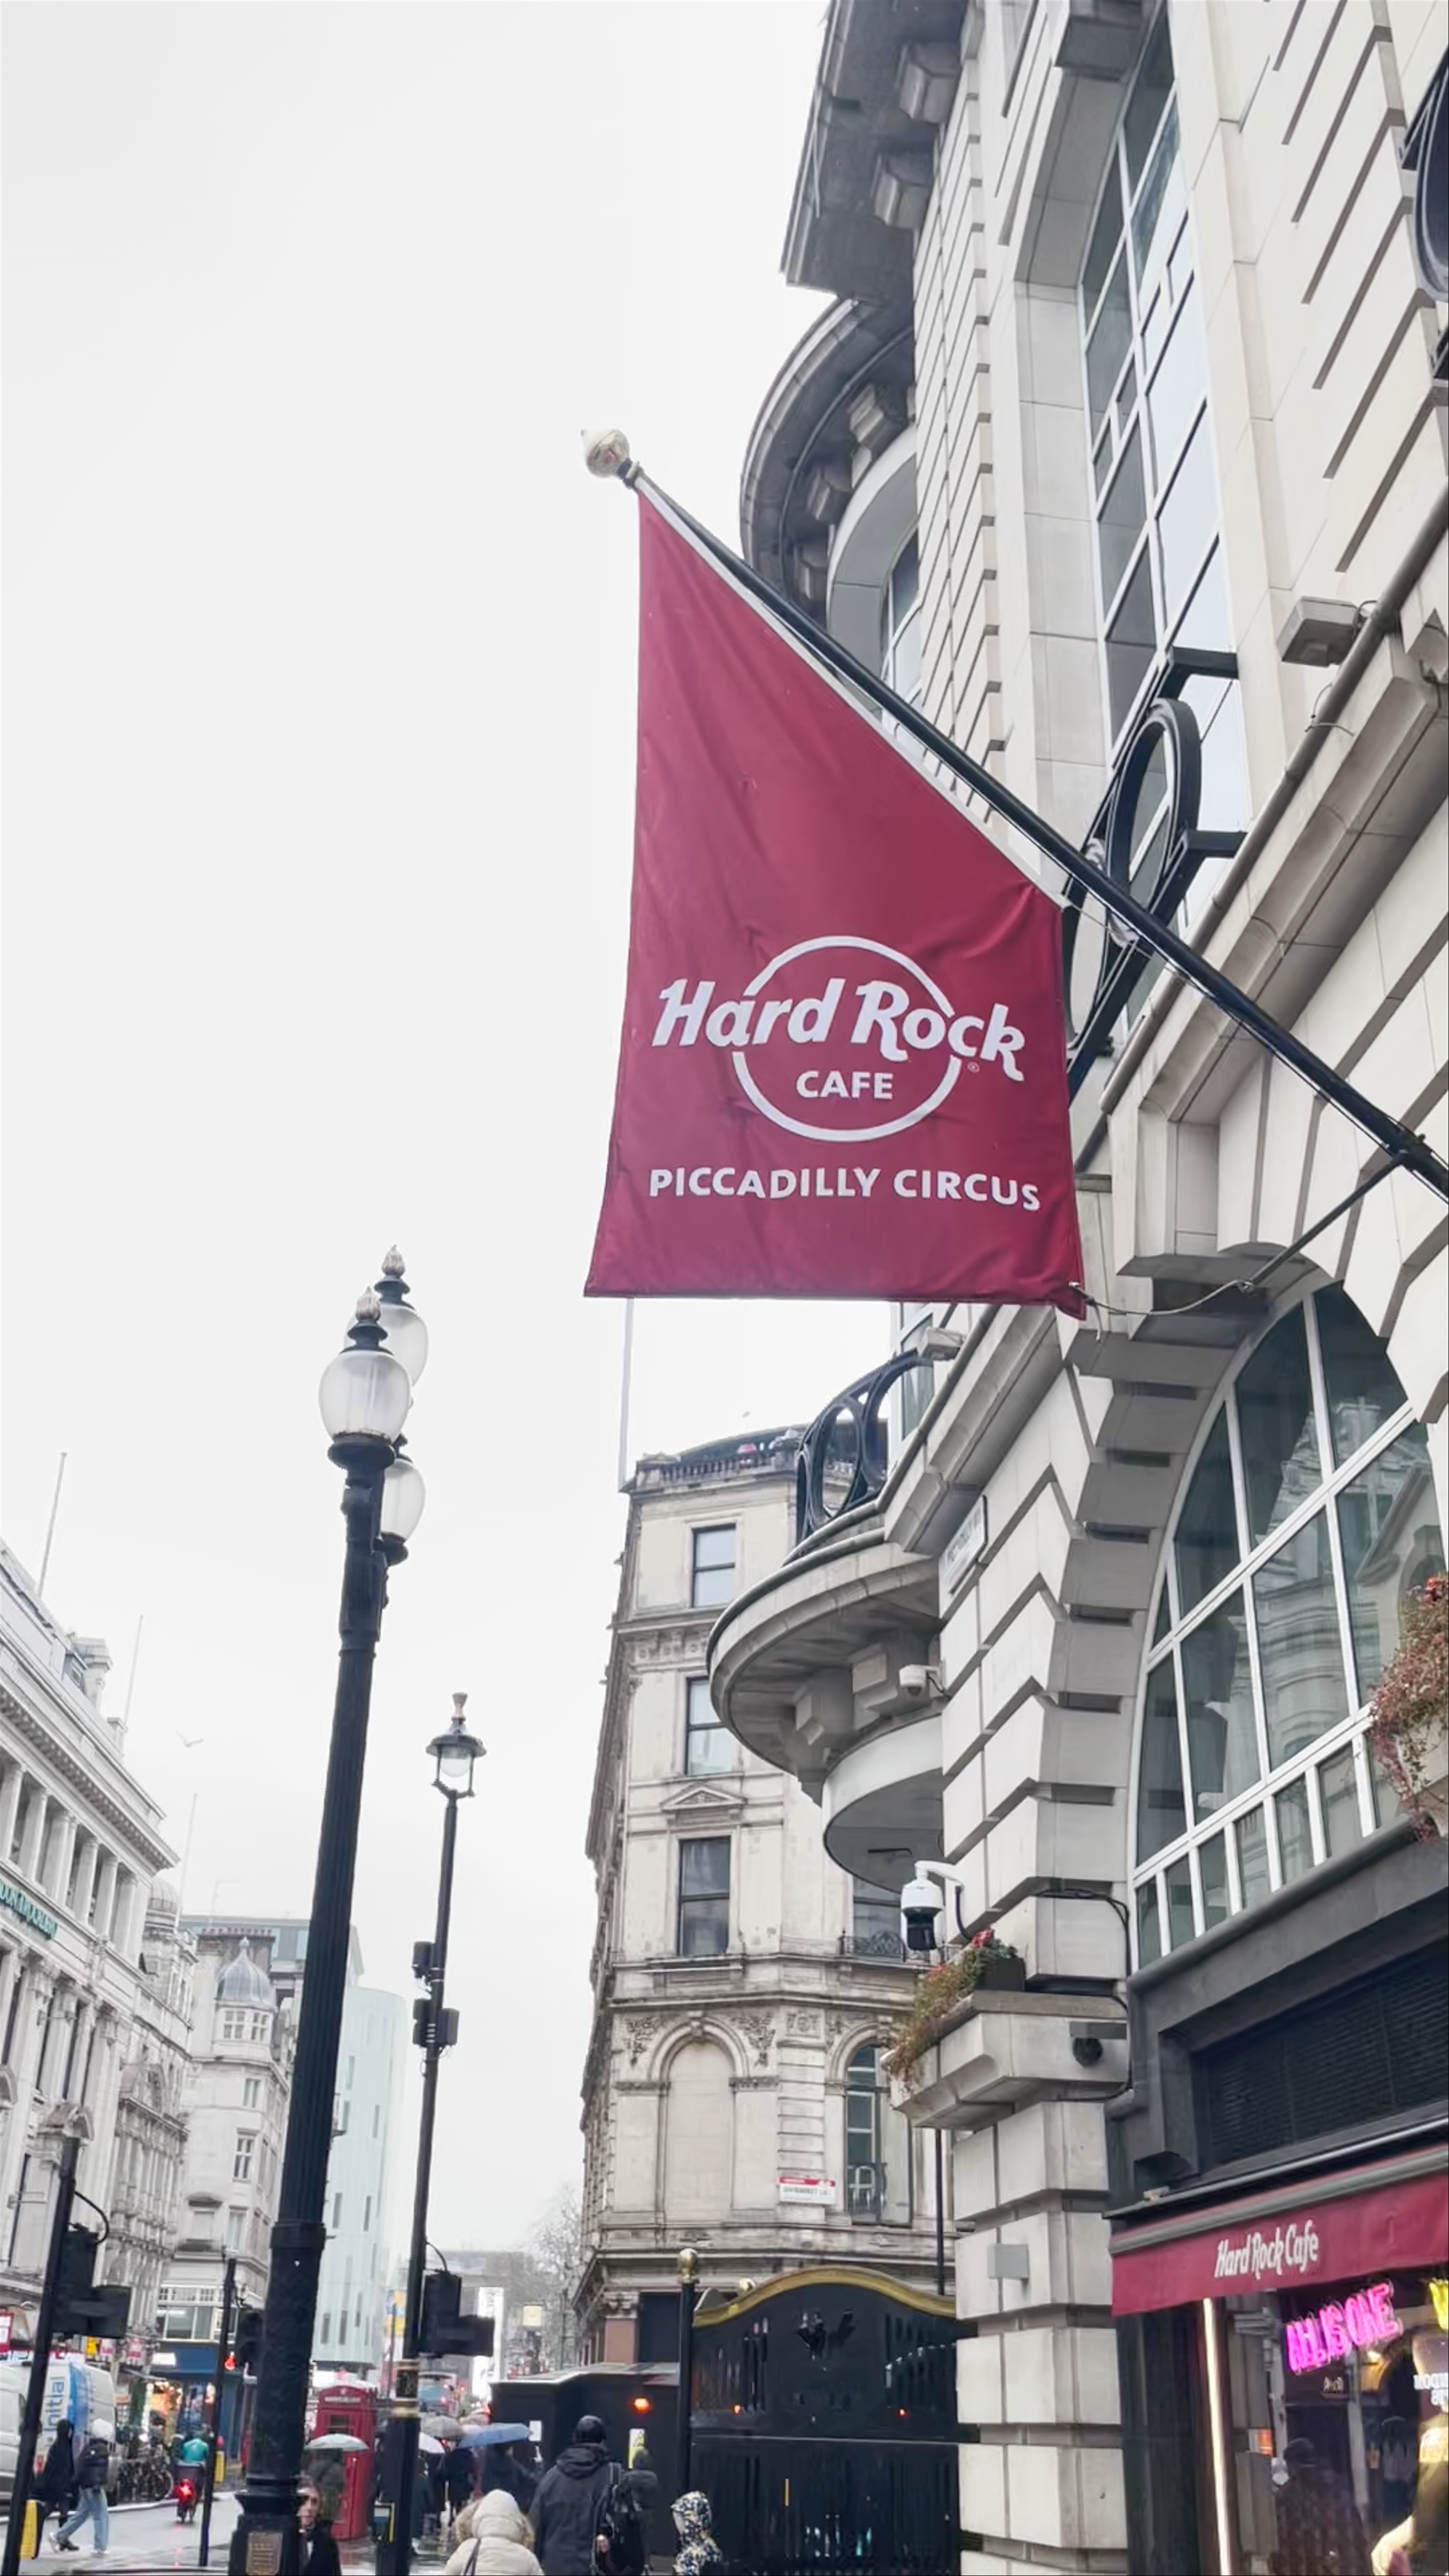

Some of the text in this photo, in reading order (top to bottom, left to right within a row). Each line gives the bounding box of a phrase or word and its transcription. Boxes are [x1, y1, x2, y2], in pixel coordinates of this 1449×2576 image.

[652, 978, 1025, 1081] Hard Rock
[796, 1070, 893, 1099] CAFE
[649, 1167, 1040, 1210] PICCADILLY CIRCUS
[1214, 2219, 1319, 2280] Hard Rock Cafe
